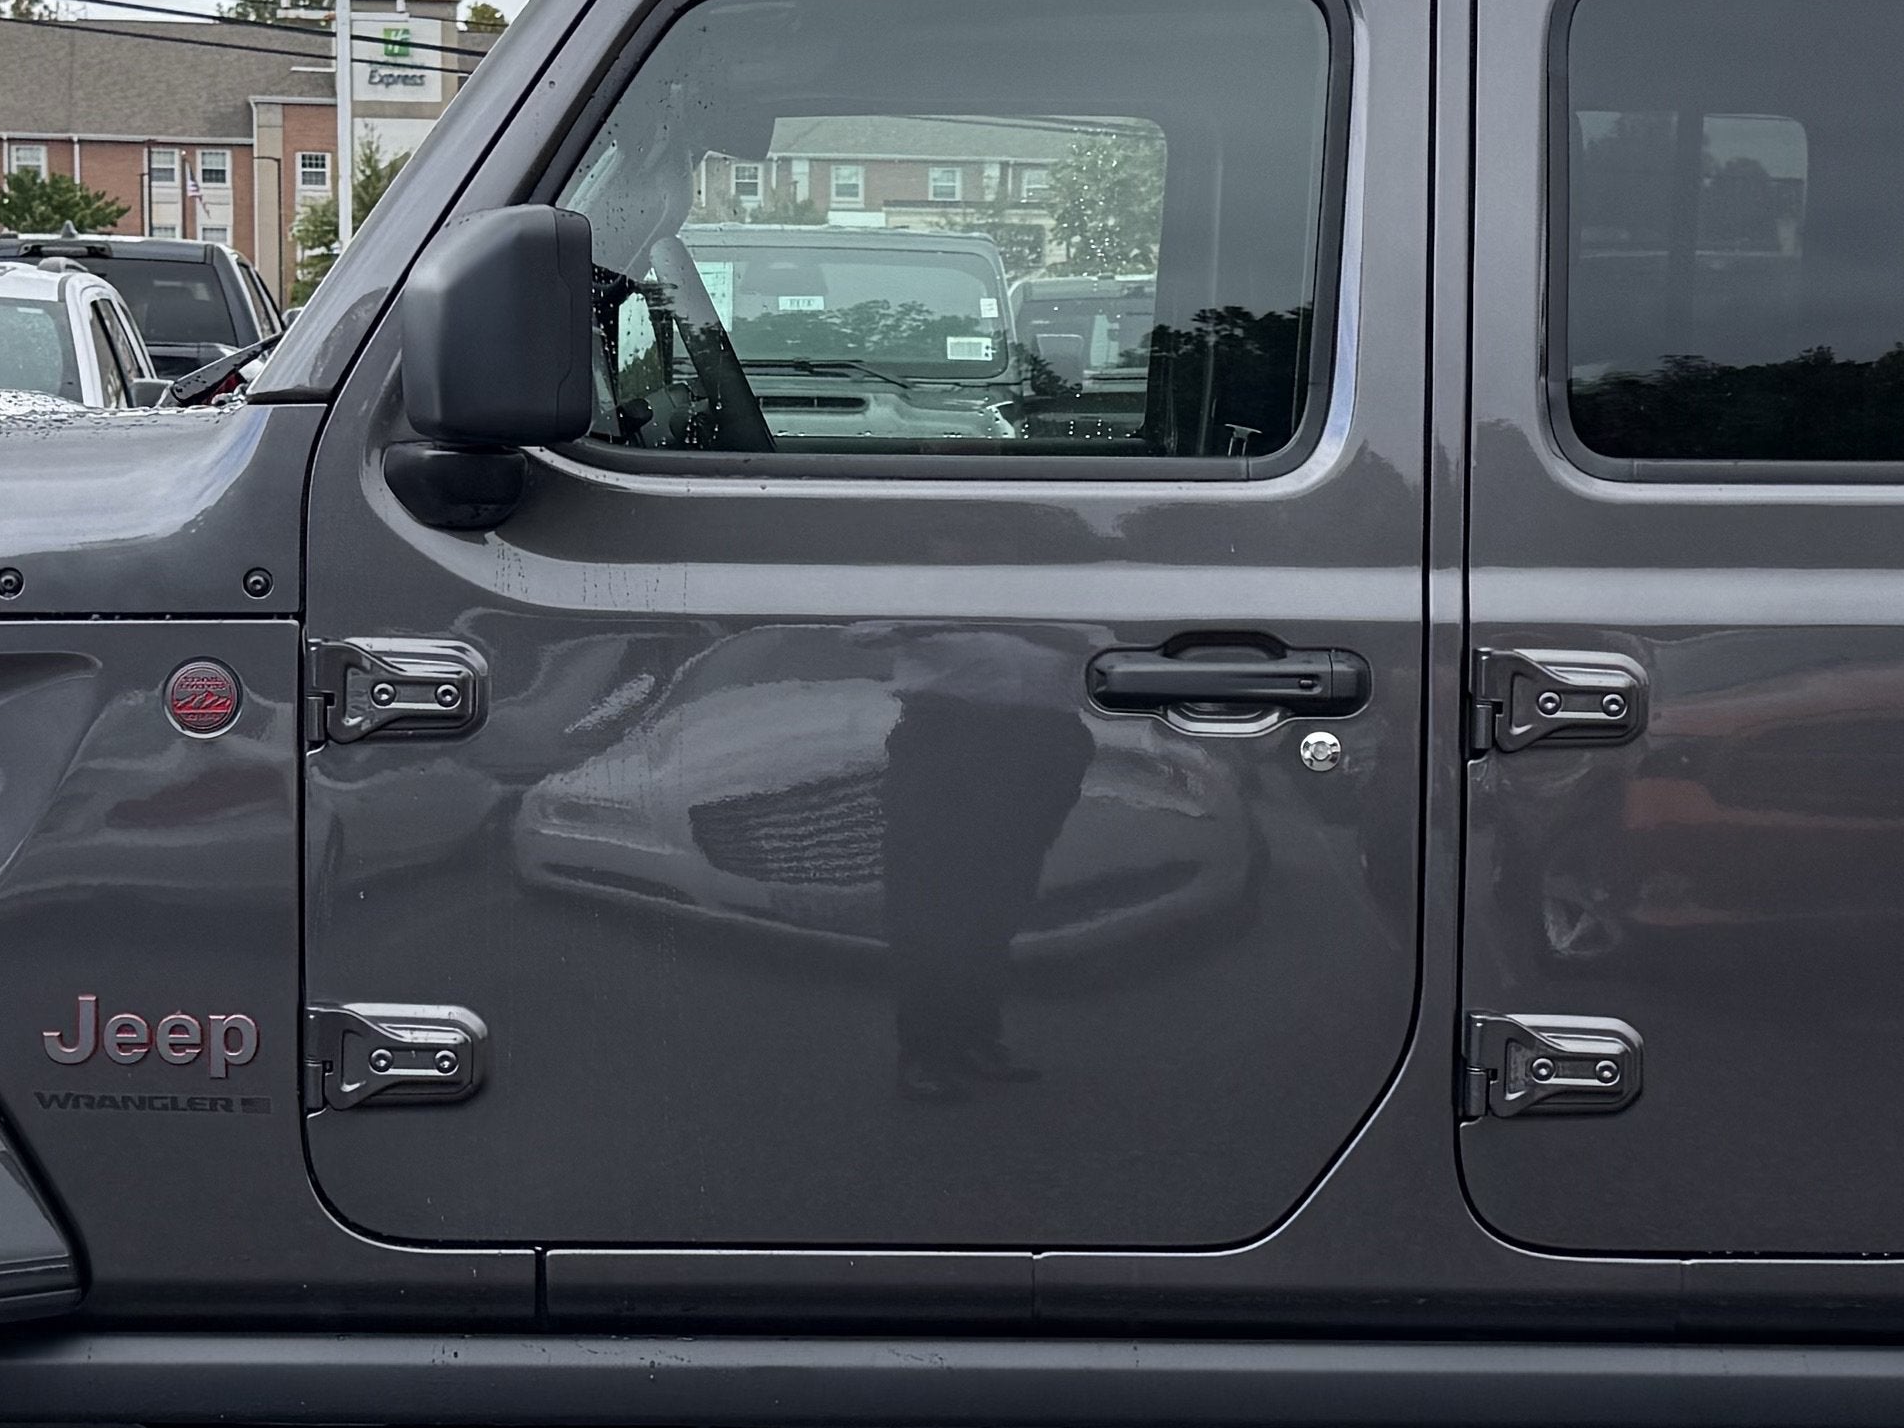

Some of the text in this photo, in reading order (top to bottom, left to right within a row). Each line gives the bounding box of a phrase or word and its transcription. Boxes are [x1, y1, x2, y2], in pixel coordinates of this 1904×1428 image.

[368, 70, 425, 88] Express
[42, 993, 259, 1079] Jeep
[33, 1091, 235, 1113] WRANGLER
